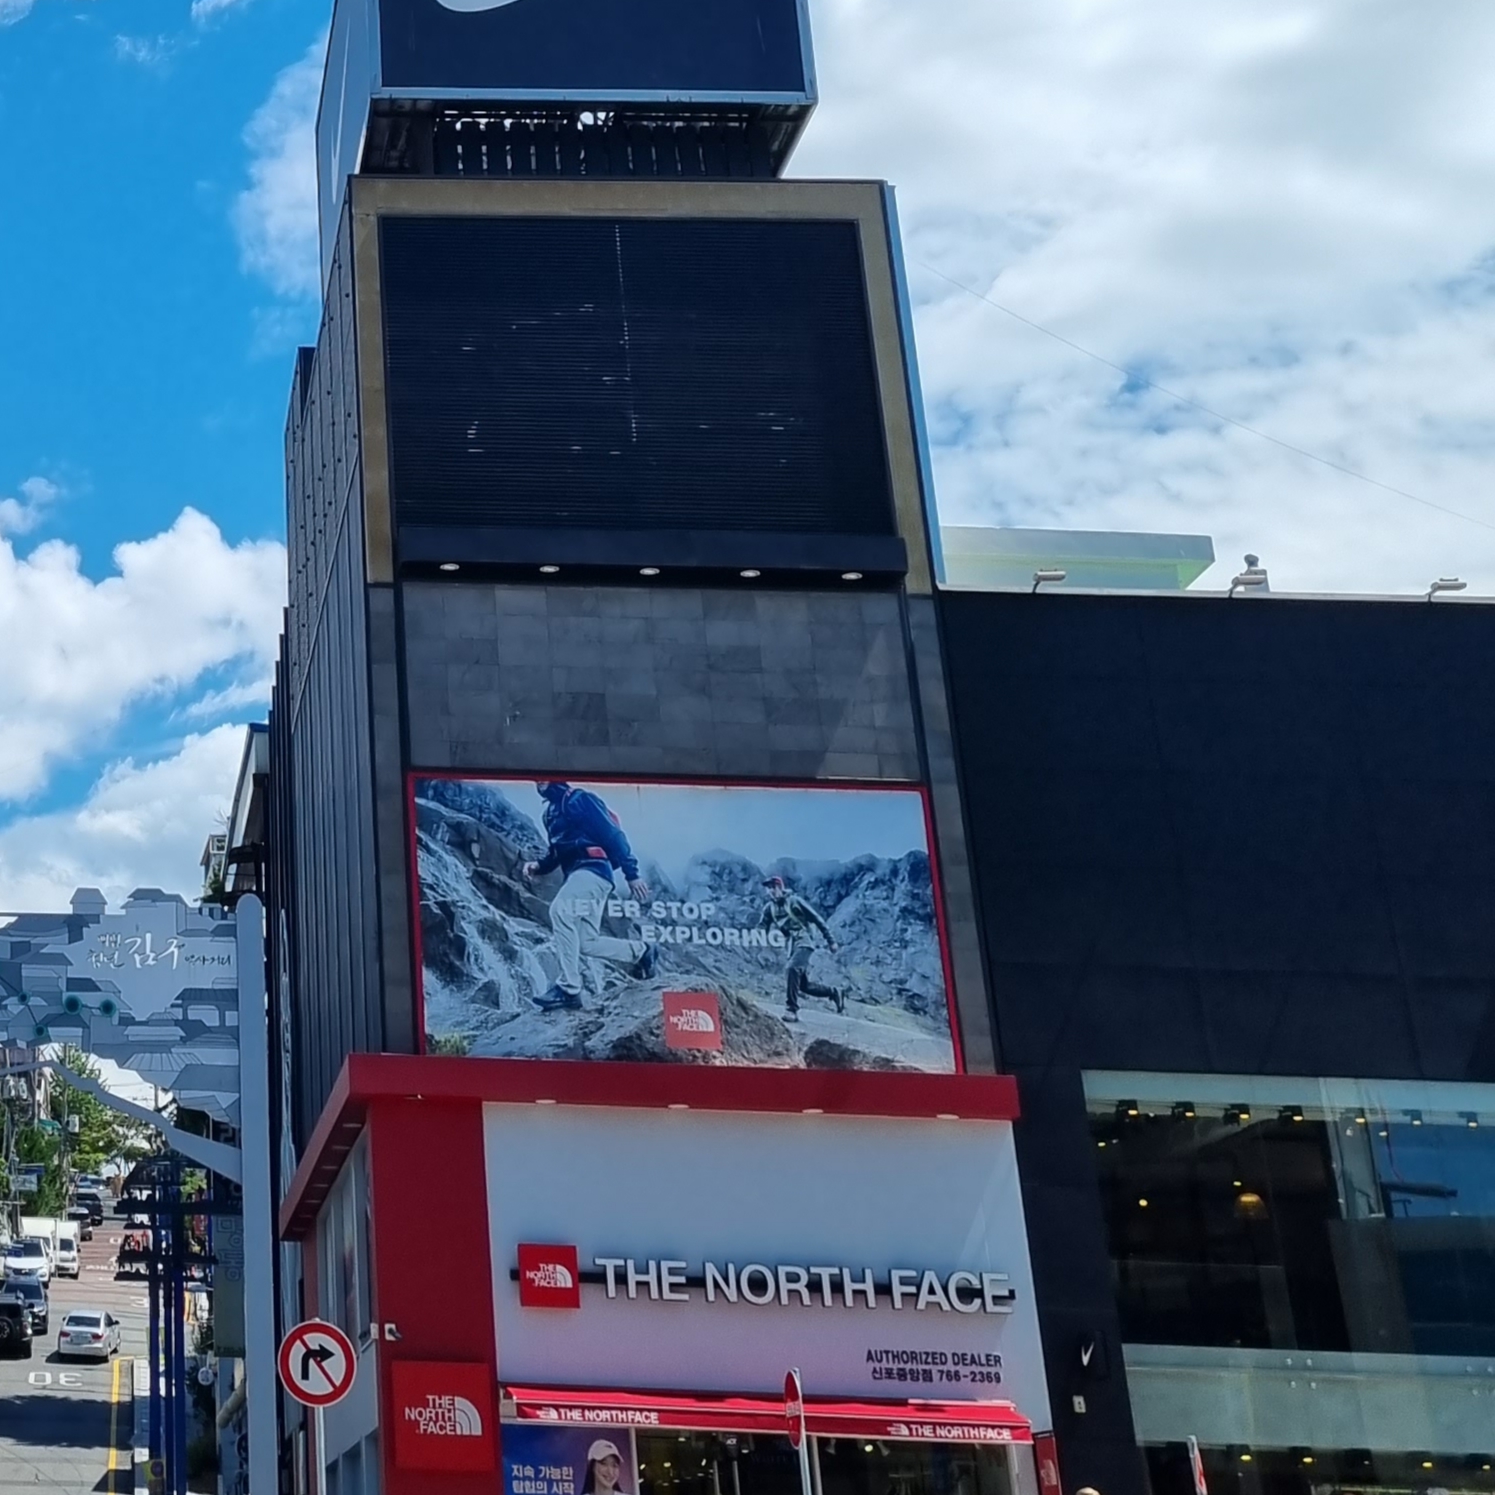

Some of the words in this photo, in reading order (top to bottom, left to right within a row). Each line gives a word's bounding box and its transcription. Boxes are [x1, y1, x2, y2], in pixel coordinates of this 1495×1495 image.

[556, 898, 641, 918] NEVER
[652, 901, 716, 920] STOP
[641, 925, 786, 948] EXPLORING
[669, 1015, 698, 1025] NORTH
[681, 1009, 698, 1017] THE
[677, 1023, 699, 1031] FACE
[526, 1270, 556, 1280] NORTH
[538, 1263, 556, 1273] THE
[533, 1278, 557, 1287] FACE
[594, 1257, 690, 1301] THE
[705, 1261, 876, 1308] NORTH
[890, 1269, 1013, 1314] FACE
[866, 1349, 948, 1366] AUTHORIZED
[951, 1352, 1002, 1367] DEALER
[872, 1366, 933, 1383] 신포중앙점
[937, 1369, 1002, 1383] 766-2369
[426, 1395, 453, 1409] THE
[404, 1407, 455, 1421] NORTH
[559, 1408, 583, 1421] THE
[584, 1410, 627, 1423] NORTH
[627, 1411, 659, 1424] FACE
[420, 1421, 455, 1435] FACE
[909, 1424, 935, 1437] THE
[936, 1426, 980, 1439] NORTH
[980, 1427, 1012, 1440] FACE
[511, 1464, 535, 1479] 지속
[538, 1465, 574, 1480] 가능한
[551, 1481, 575, 1495] 시작
